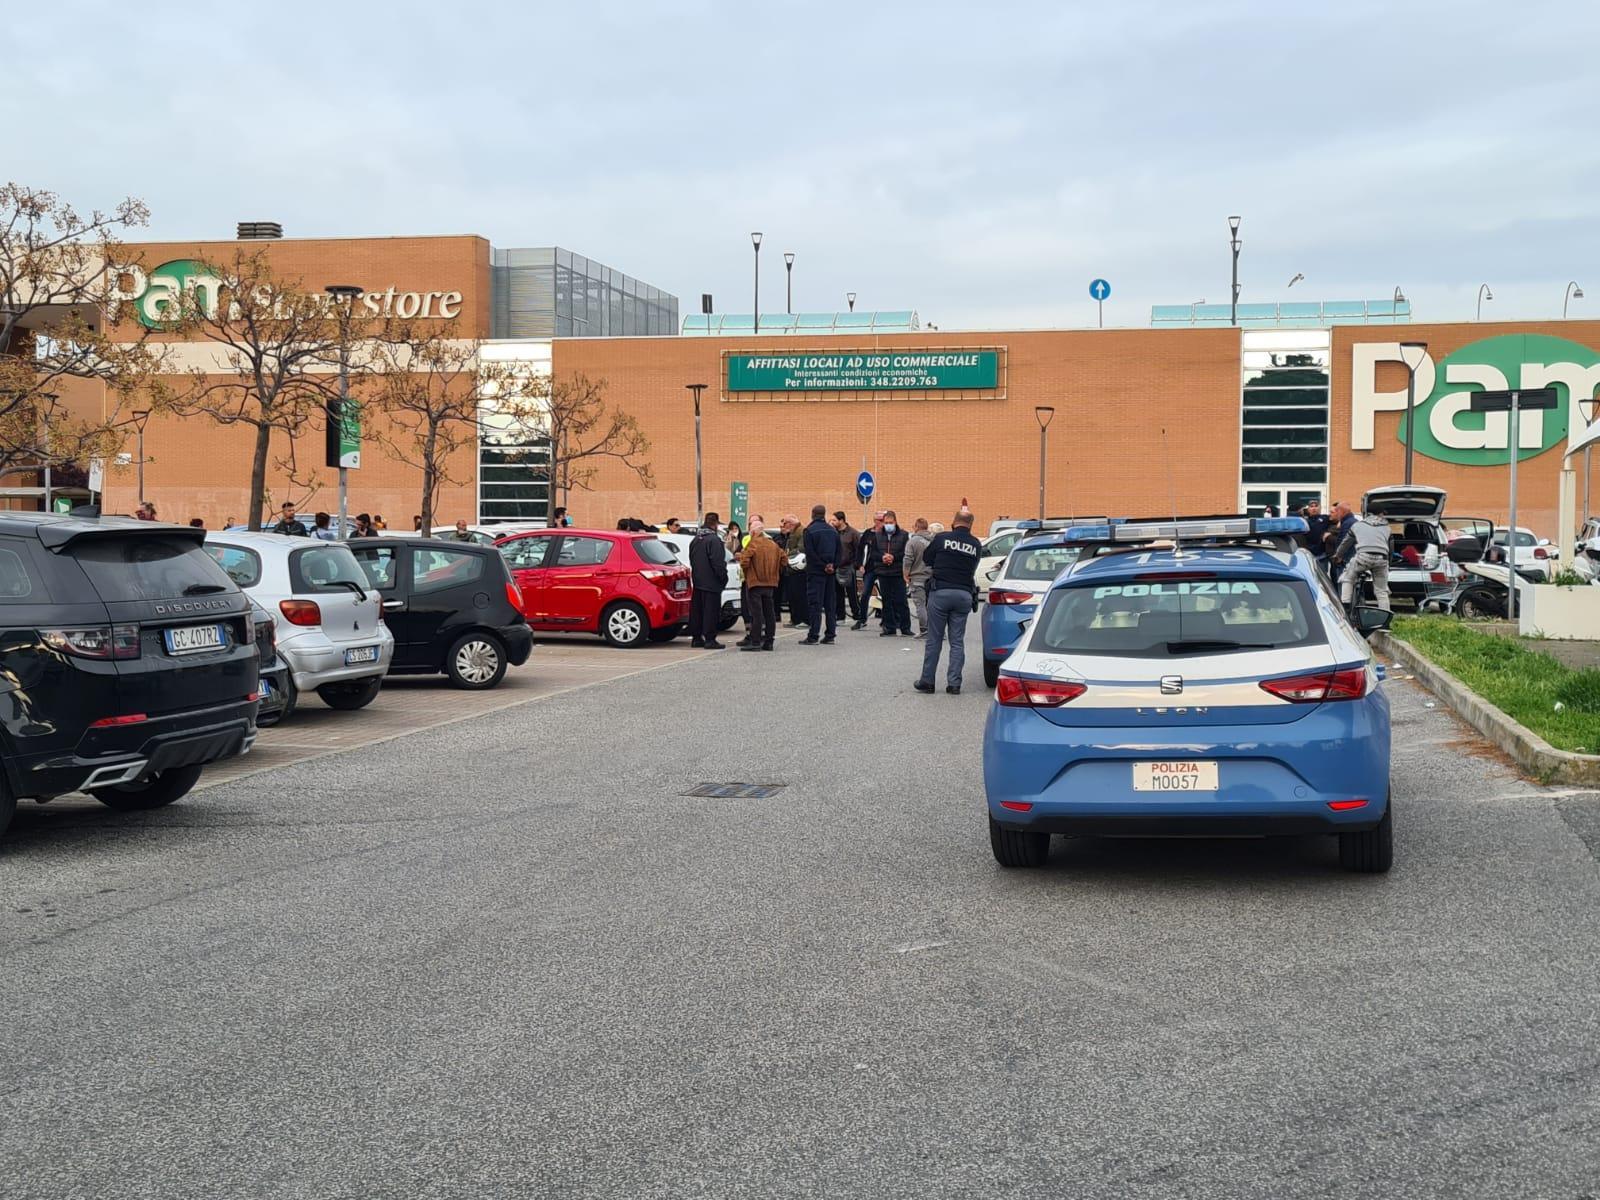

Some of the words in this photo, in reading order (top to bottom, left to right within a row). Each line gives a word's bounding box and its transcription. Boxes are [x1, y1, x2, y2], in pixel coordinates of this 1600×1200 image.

[747, 357, 801, 369] AFFITTASI
[803, 356, 843, 369] LOCALI
[846, 356, 863, 368] AD
[866, 356, 890, 368] USO
[893, 354, 979, 368] COMMERCIALE
[794, 369, 839, 378] Interessanti
[840, 369, 880, 377] condizioni
[882, 368, 928, 377] economiche
[785, 377, 801, 388] Per
[804, 376, 868, 387] informazioni:
[870, 375, 938, 387] 348.2209.763
[944, 539, 977, 557] POLIZIA
[1094, 582, 1261, 599] POLIZIA
[155, 600, 232, 613] DISCOVERY
[1151, 763, 1199, 773] POLIZIA
